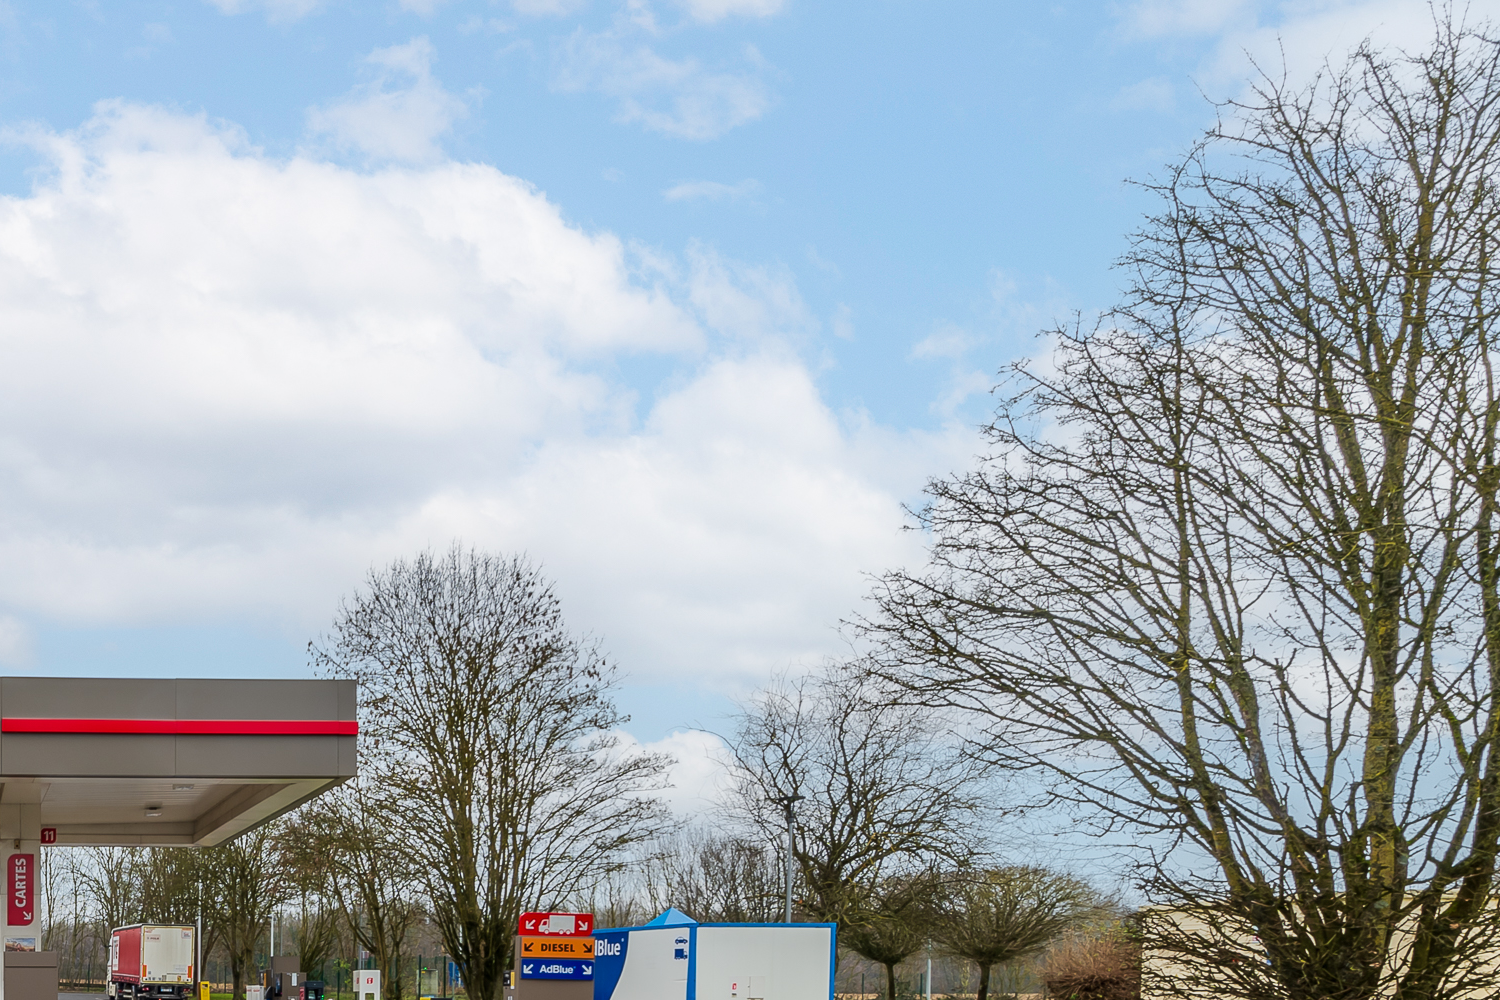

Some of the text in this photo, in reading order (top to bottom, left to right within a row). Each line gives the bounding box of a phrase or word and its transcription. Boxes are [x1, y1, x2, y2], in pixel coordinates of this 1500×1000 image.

[43, 830, 54, 841] 11
[14, 858, 26, 908] CARTES
[540, 943, 576, 953] DIESEL
[539, 964, 574, 974] AdBlue
